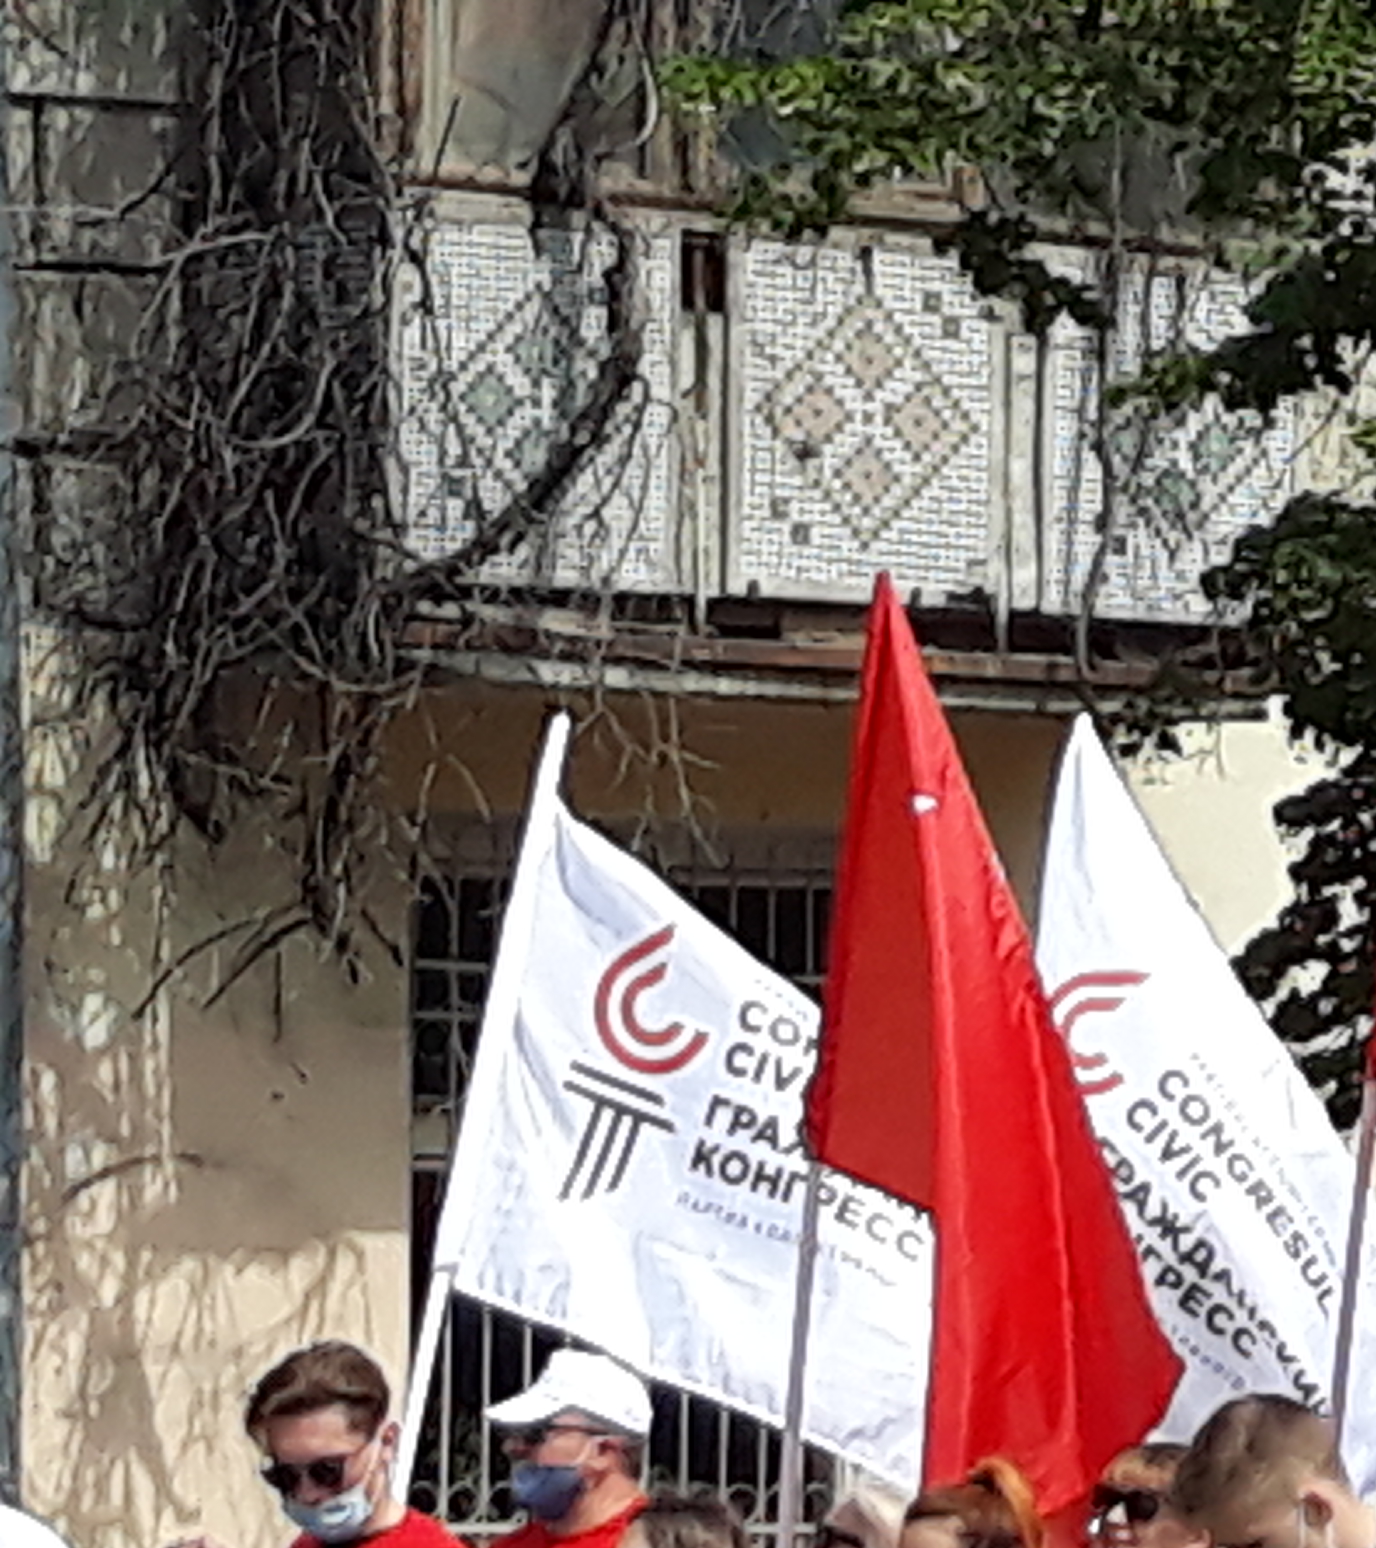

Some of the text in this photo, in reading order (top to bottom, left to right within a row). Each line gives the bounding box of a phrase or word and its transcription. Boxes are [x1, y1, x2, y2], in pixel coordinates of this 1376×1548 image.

[689, 1138, 925, 1263] КОНГРЕСС
[1126, 1097, 1221, 1203] CIVIC
[1157, 1068, 1336, 1320] CONGRESUL
[1133, 1232, 1259, 1360] ГРЕСС
